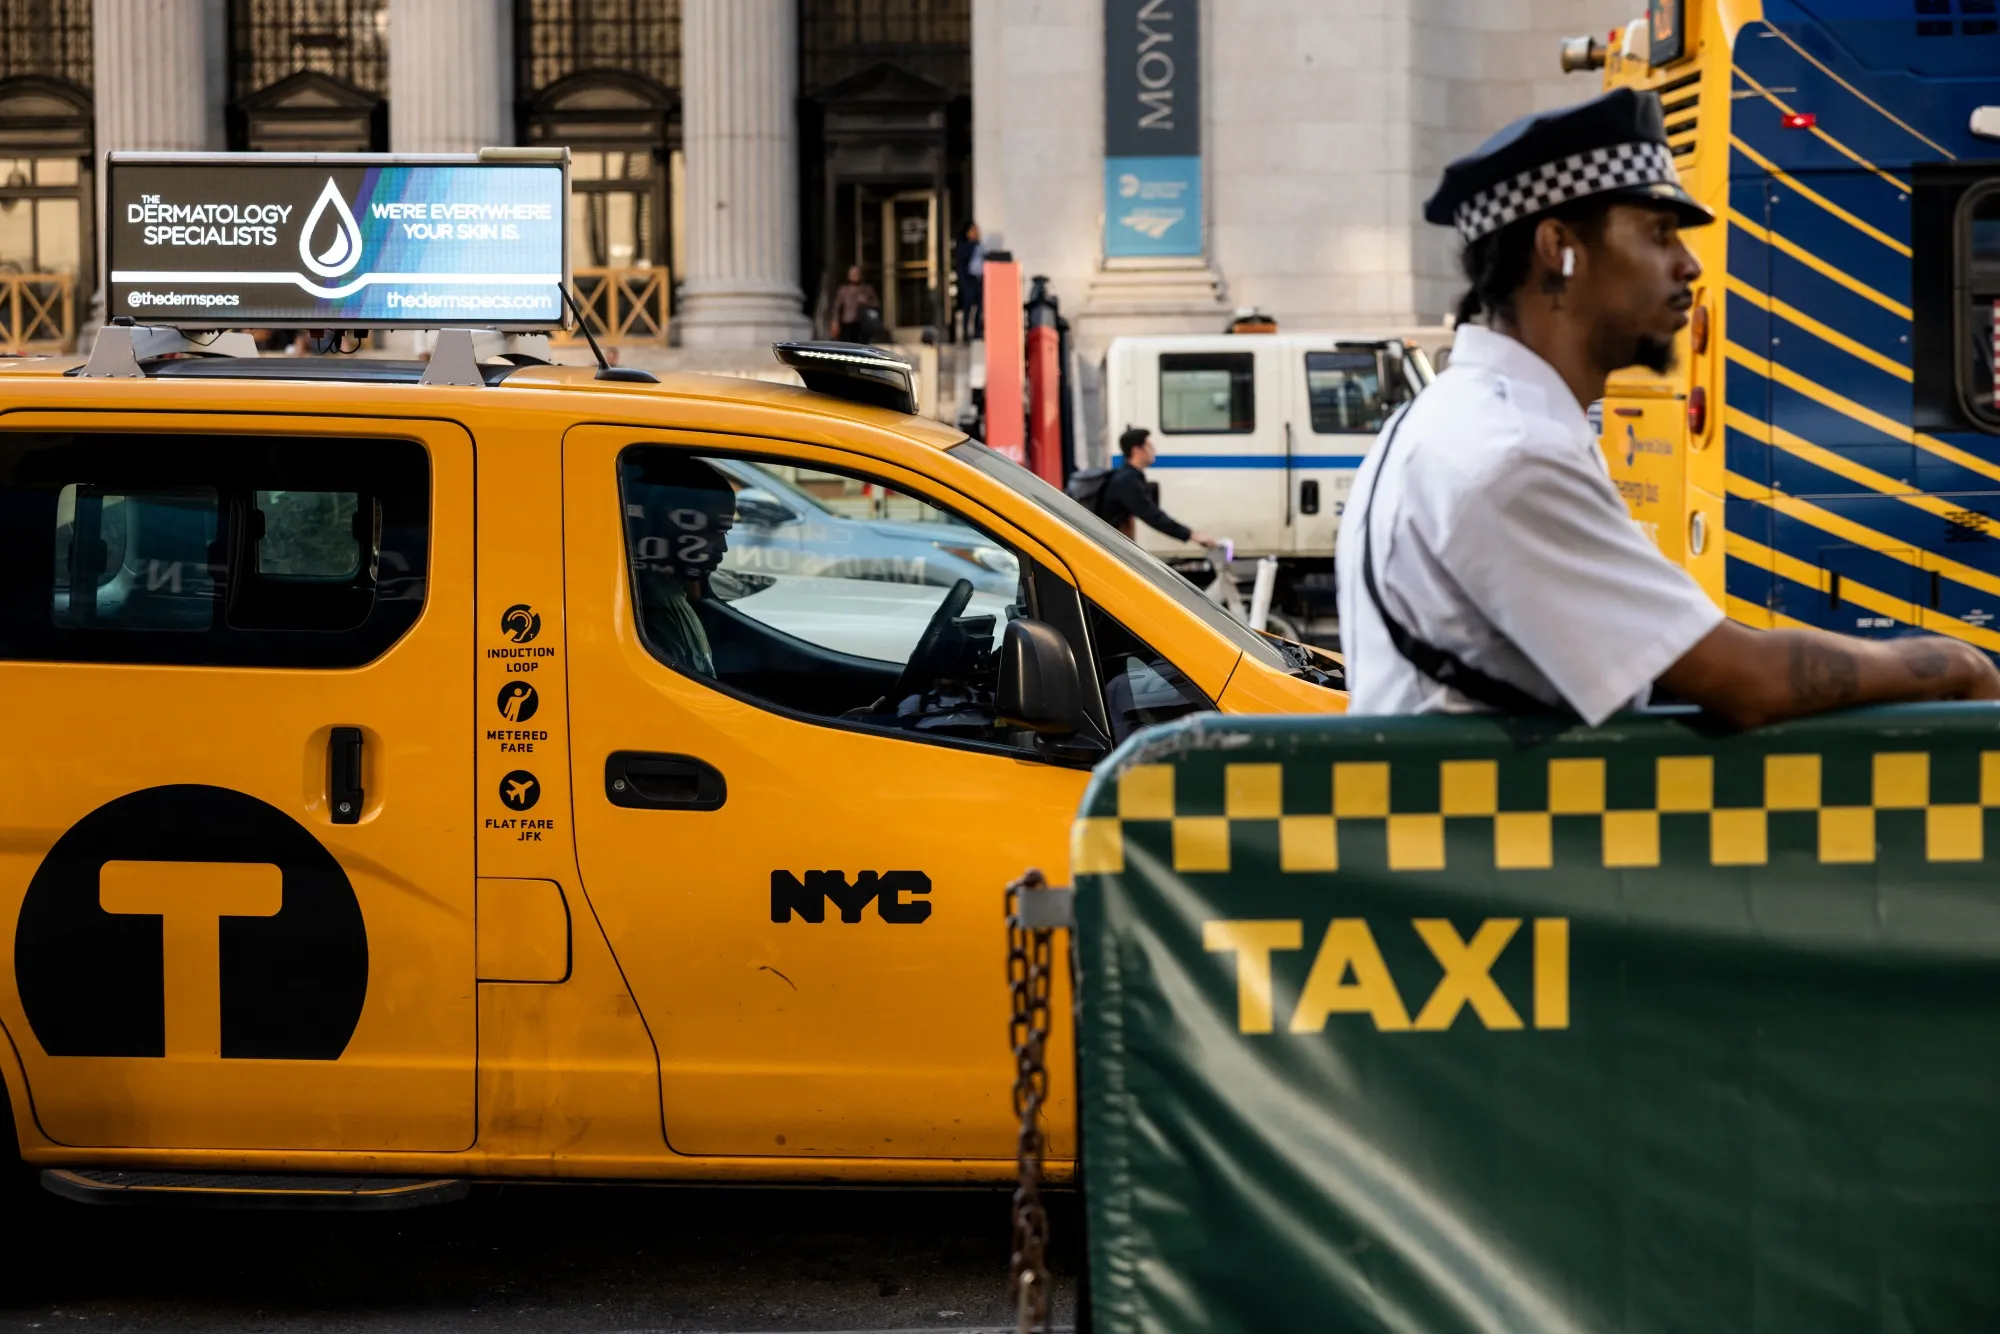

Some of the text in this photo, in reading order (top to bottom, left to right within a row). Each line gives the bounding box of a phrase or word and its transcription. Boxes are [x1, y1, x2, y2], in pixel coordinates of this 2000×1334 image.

[141, 194, 161, 204] THE
[127, 204, 293, 224] DERMATOLOGY
[371, 203, 552, 220] WE'RE EVERYWHERE
[143, 226, 278, 246] SPECIALISTS
[403, 223, 520, 240] YOUR SKIN IS.
[127, 291, 240, 308] @thedermspecs
[386, 291, 552, 310] thedermspecs.com
[487, 648, 555, 659] INDUCTION
[506, 663, 539, 672] LOOP
[487, 730, 548, 741] METERED
[501, 743, 534, 753] FARE
[485, 819, 554, 830] FLAT FARE
[517, 831, 542, 841] JFK
[771, 869, 932, 924] NYC
[99, 860, 283, 1059] T
[1203, 917, 1570, 1035] TAXI
